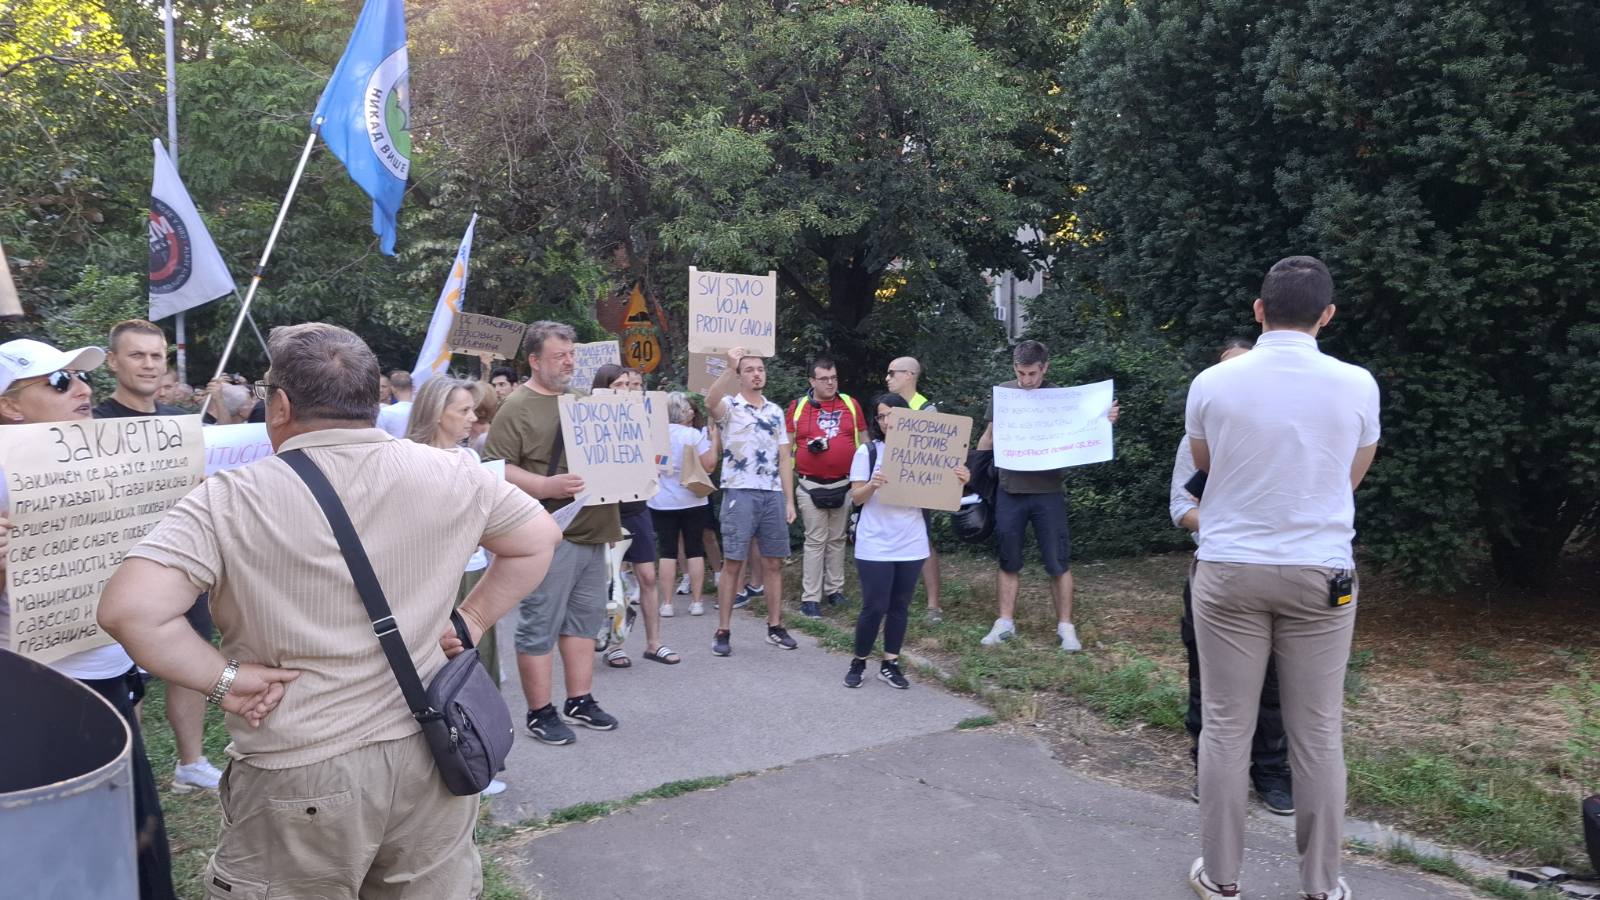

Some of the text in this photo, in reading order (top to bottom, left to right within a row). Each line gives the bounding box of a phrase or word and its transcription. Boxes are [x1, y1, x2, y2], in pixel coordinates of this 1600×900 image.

[369, 86, 408, 173] НИКАД ВИШЕ
[697, 275, 763, 297] SVI SMO
[716, 297, 749, 315] VOJA
[696, 313, 773, 336] PROTIV GNOJA
[631, 340, 653, 362] 40
[566, 402, 635, 423] VIDIKOVAC
[574, 422, 644, 446] BI DA VAM
[897, 417, 958, 438] РАКОВИЦА
[907, 434, 948, 451] ПРОТИВ
[583, 444, 608, 466] VIDI
[86, 467, 100, 481] се
[103, 465, 118, 478] да
[42, 536, 80, 557] своје
[83, 531, 119, 549] снаге
[15, 607, 79, 635] савесно
